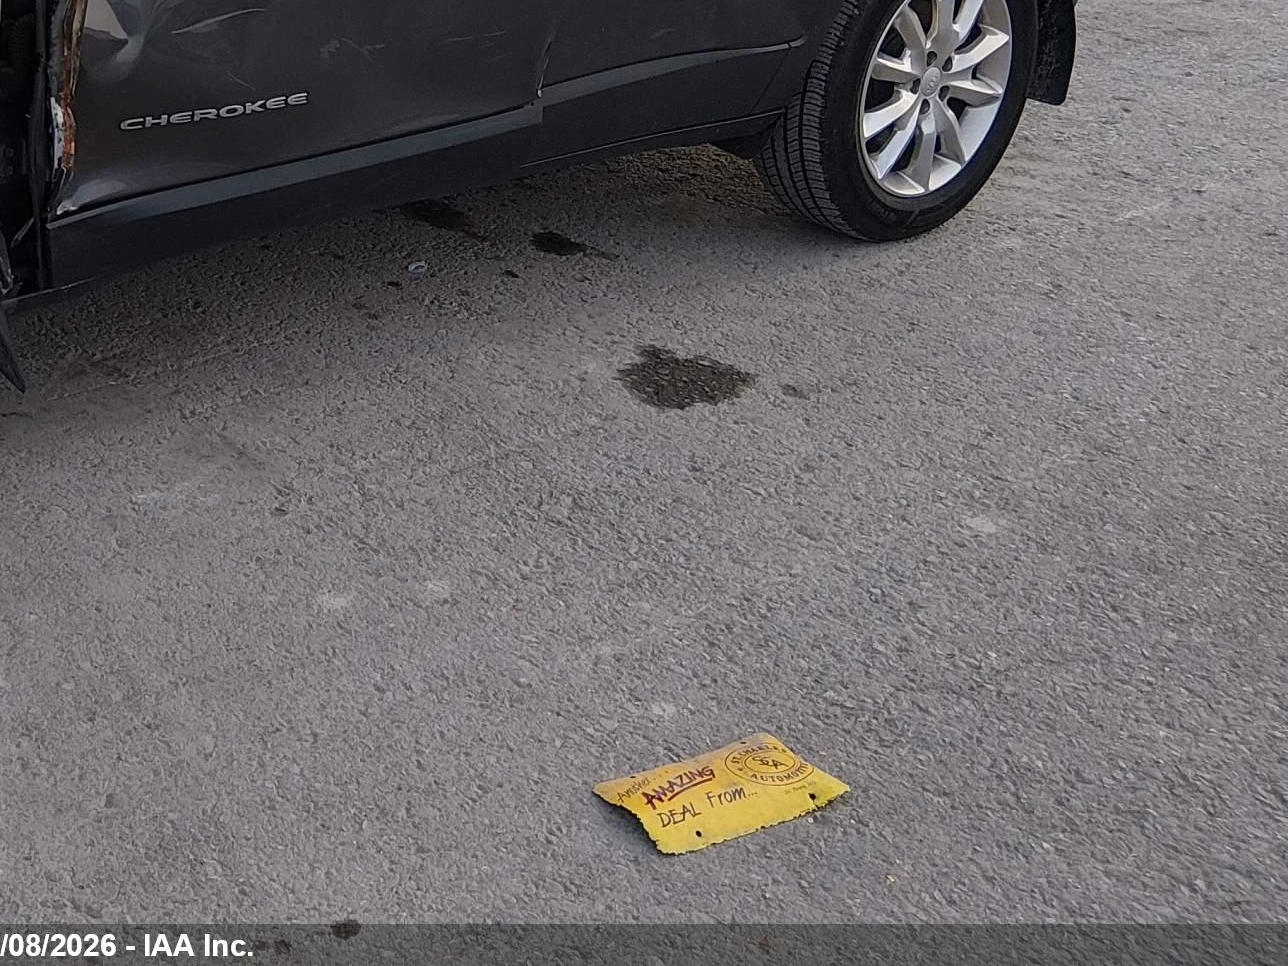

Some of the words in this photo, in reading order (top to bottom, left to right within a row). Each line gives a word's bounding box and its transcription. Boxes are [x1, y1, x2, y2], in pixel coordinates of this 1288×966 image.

[120, 92, 309, 131] CHEROKEE
[642, 766, 716, 810] AMAZING
[656, 802, 702, 828] DEAL
